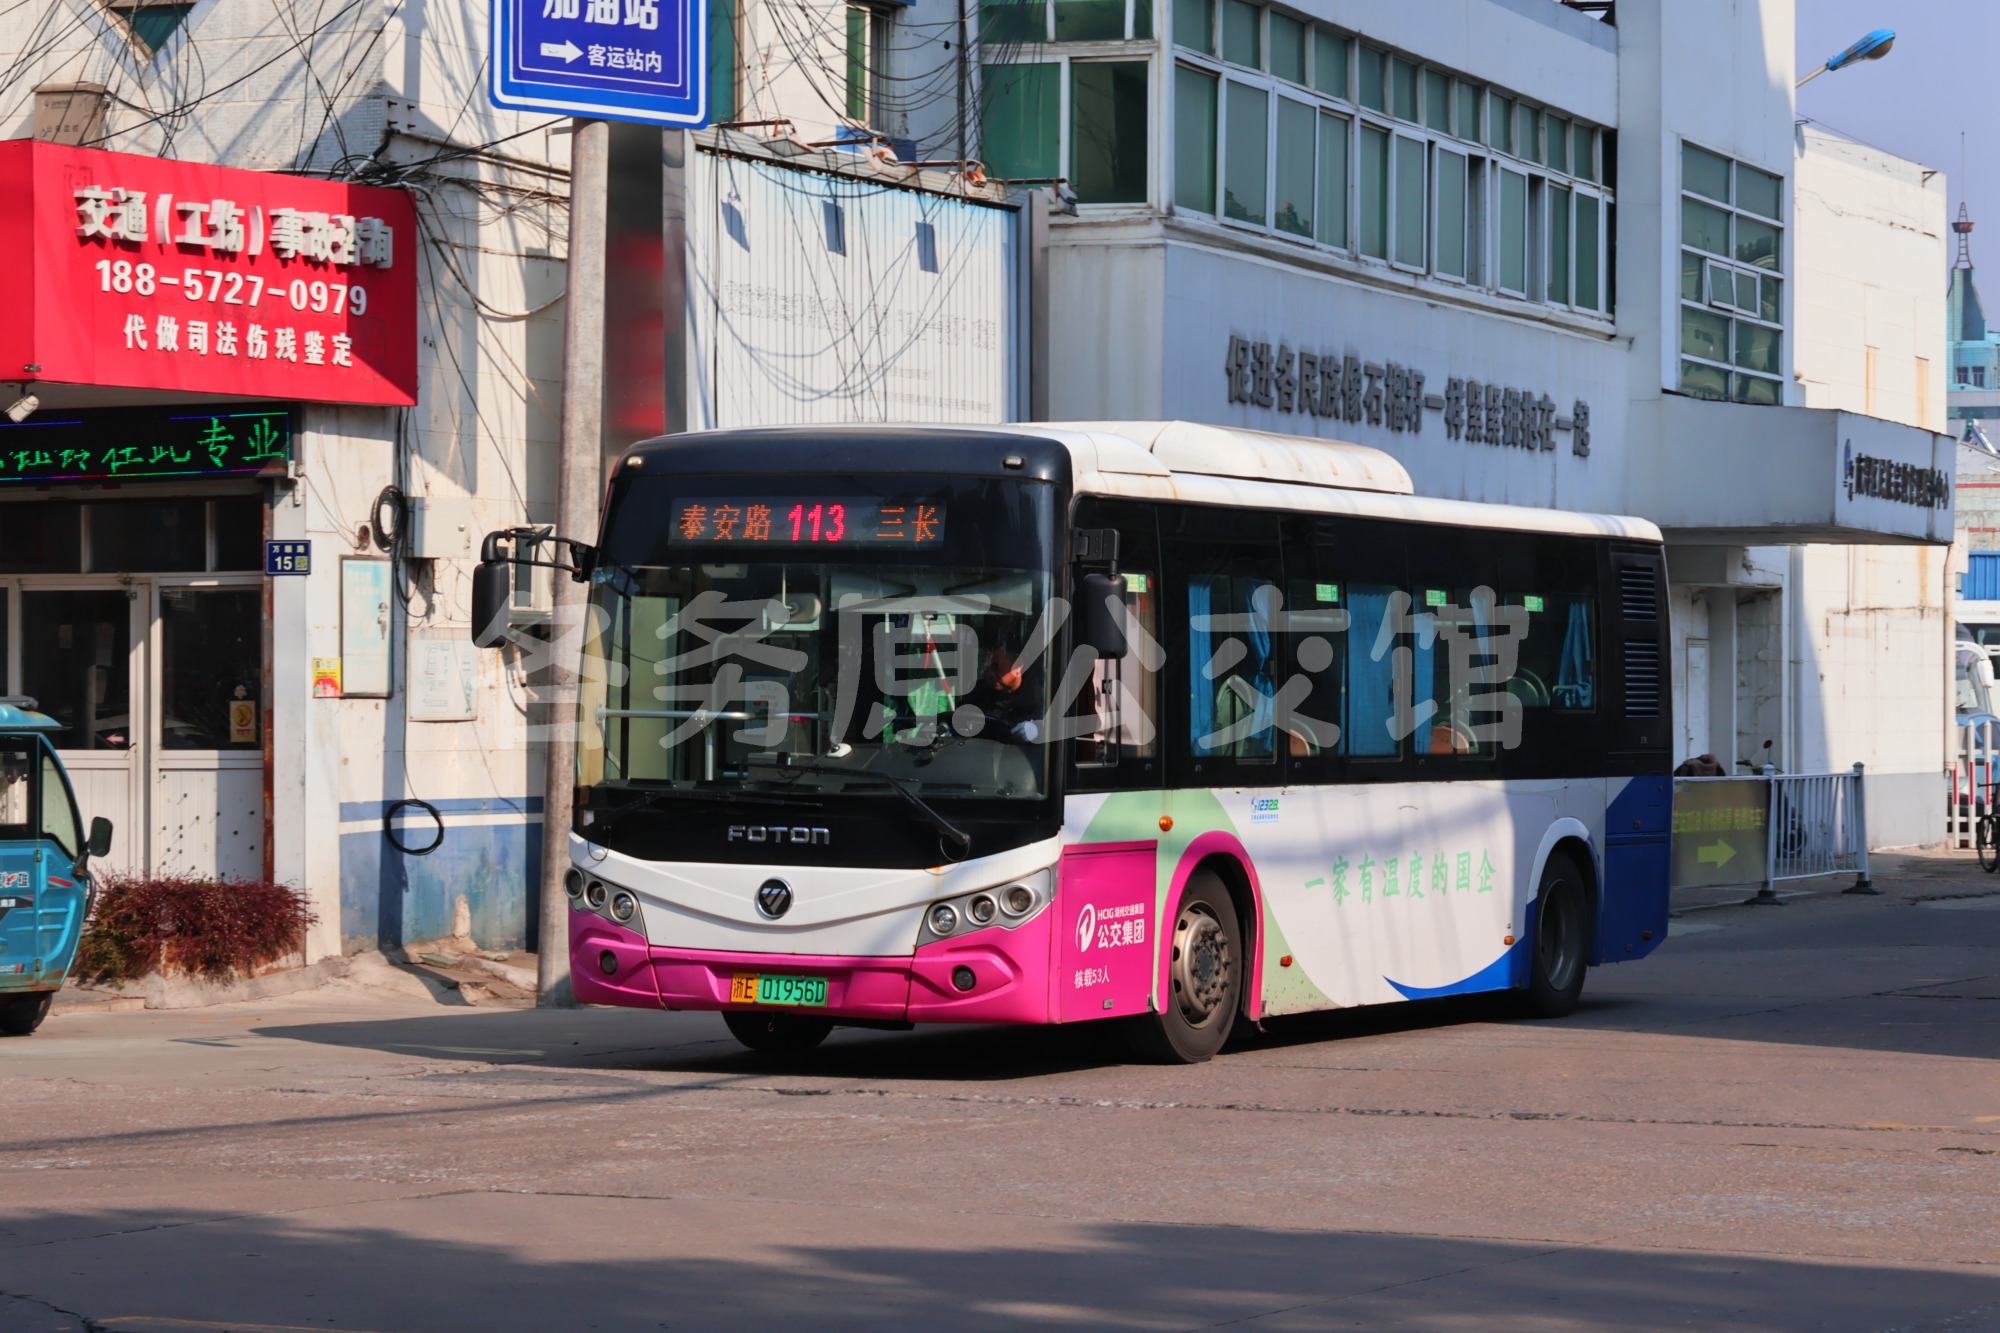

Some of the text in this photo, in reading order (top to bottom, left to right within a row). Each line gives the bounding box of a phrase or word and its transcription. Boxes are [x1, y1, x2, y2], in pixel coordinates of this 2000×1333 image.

[587, 44, 662, 74] 客运站内
[96, 260, 367, 316] 188-5727-0979
[124, 314, 353, 367] 代做司法伤残鉴定
[1226, 335, 1590, 457] 促进各民族像石榴籽一样紧紧拥抱在一起
[680, 505, 938, 541] 泰安路 113 三长
[275, 556, 293, 570] 15
[728, 825, 830, 845] FOTON
[1305, 848, 1496, 907] 一家有温度的国企
[1098, 918, 1145, 949] 公交集团
[1075, 965, 1110, 989] 核载53人
